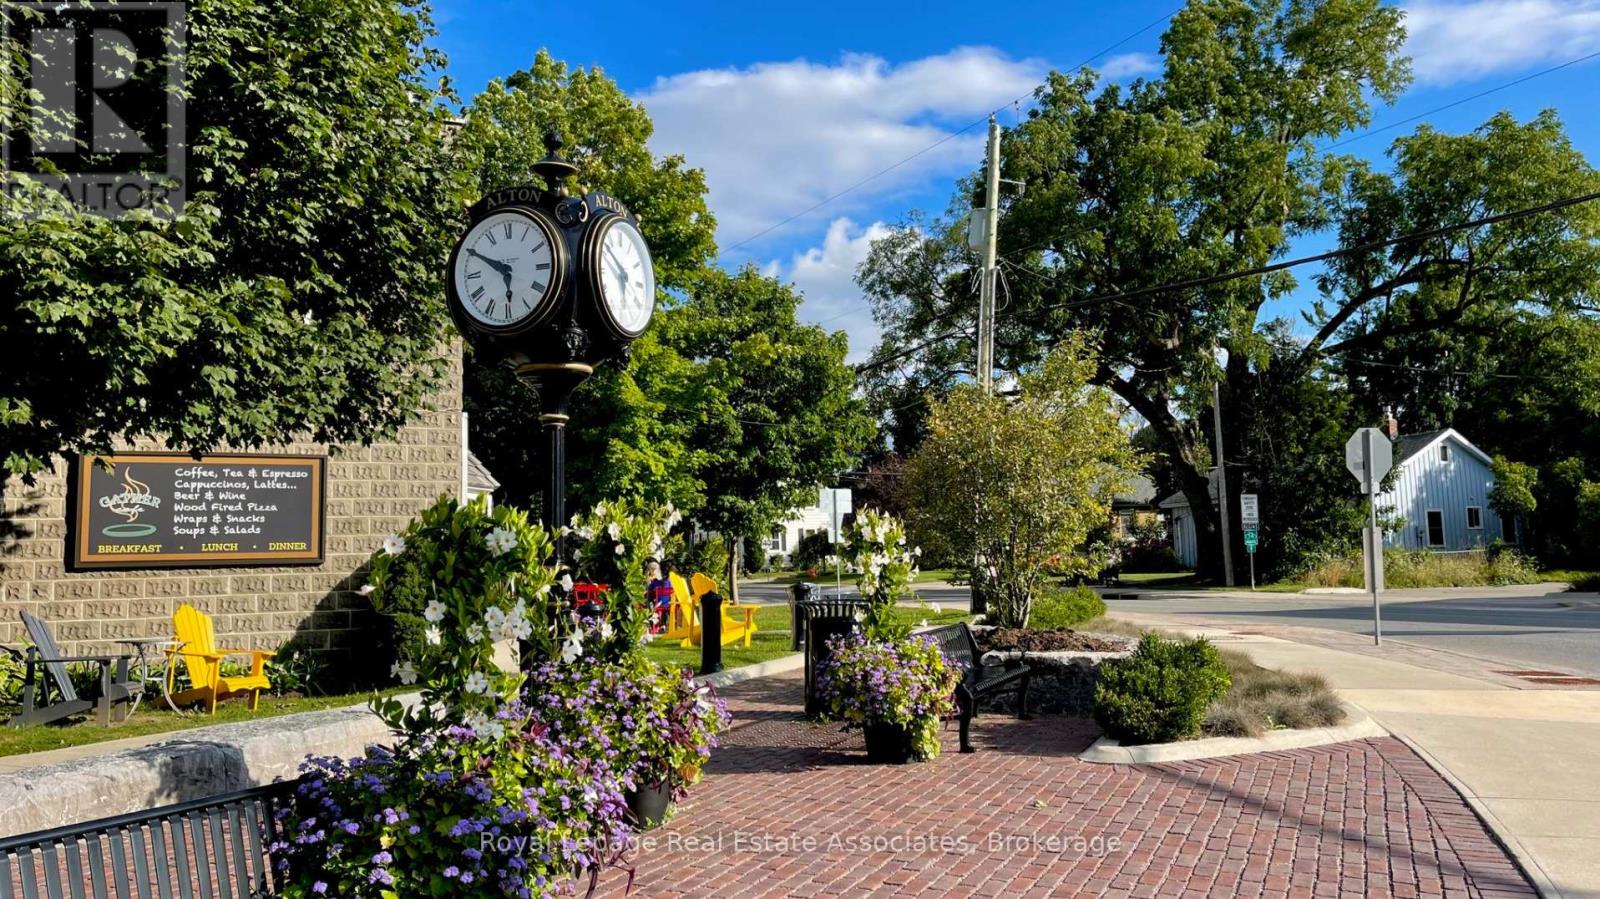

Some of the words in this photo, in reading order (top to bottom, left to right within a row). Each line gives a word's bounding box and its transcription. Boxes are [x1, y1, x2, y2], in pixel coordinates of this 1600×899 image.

[487, 188, 542, 210] ALTON
[595, 194, 627, 217] ALTON
[174, 467, 218, 479] Coffee,
[223, 468, 244, 478] Tea
[248, 468, 257, 479] &
[262, 469, 308, 482] Espresso
[174, 480, 250, 492] Cappuccinos,
[254, 480, 297, 489] Lattes...
[174, 491, 200, 500] Beer
[204, 490, 214, 501] &
[219, 491, 246, 500] Wine
[174, 502, 207, 511] Wood
[211, 502, 243, 511] Fired
[247, 503, 278, 511] Pizza
[173, 514, 208, 527] Wraps
[212, 513, 222, 524] &
[226, 514, 266, 523] Snacks
[173, 526, 206, 539] Soups
[209, 525, 219, 535] &
[224, 525, 262, 534] Salads
[98, 544, 162, 553] BREAKFAST
[202, 543, 239, 552] LUNCH
[268, 542, 307, 551] DINNER
